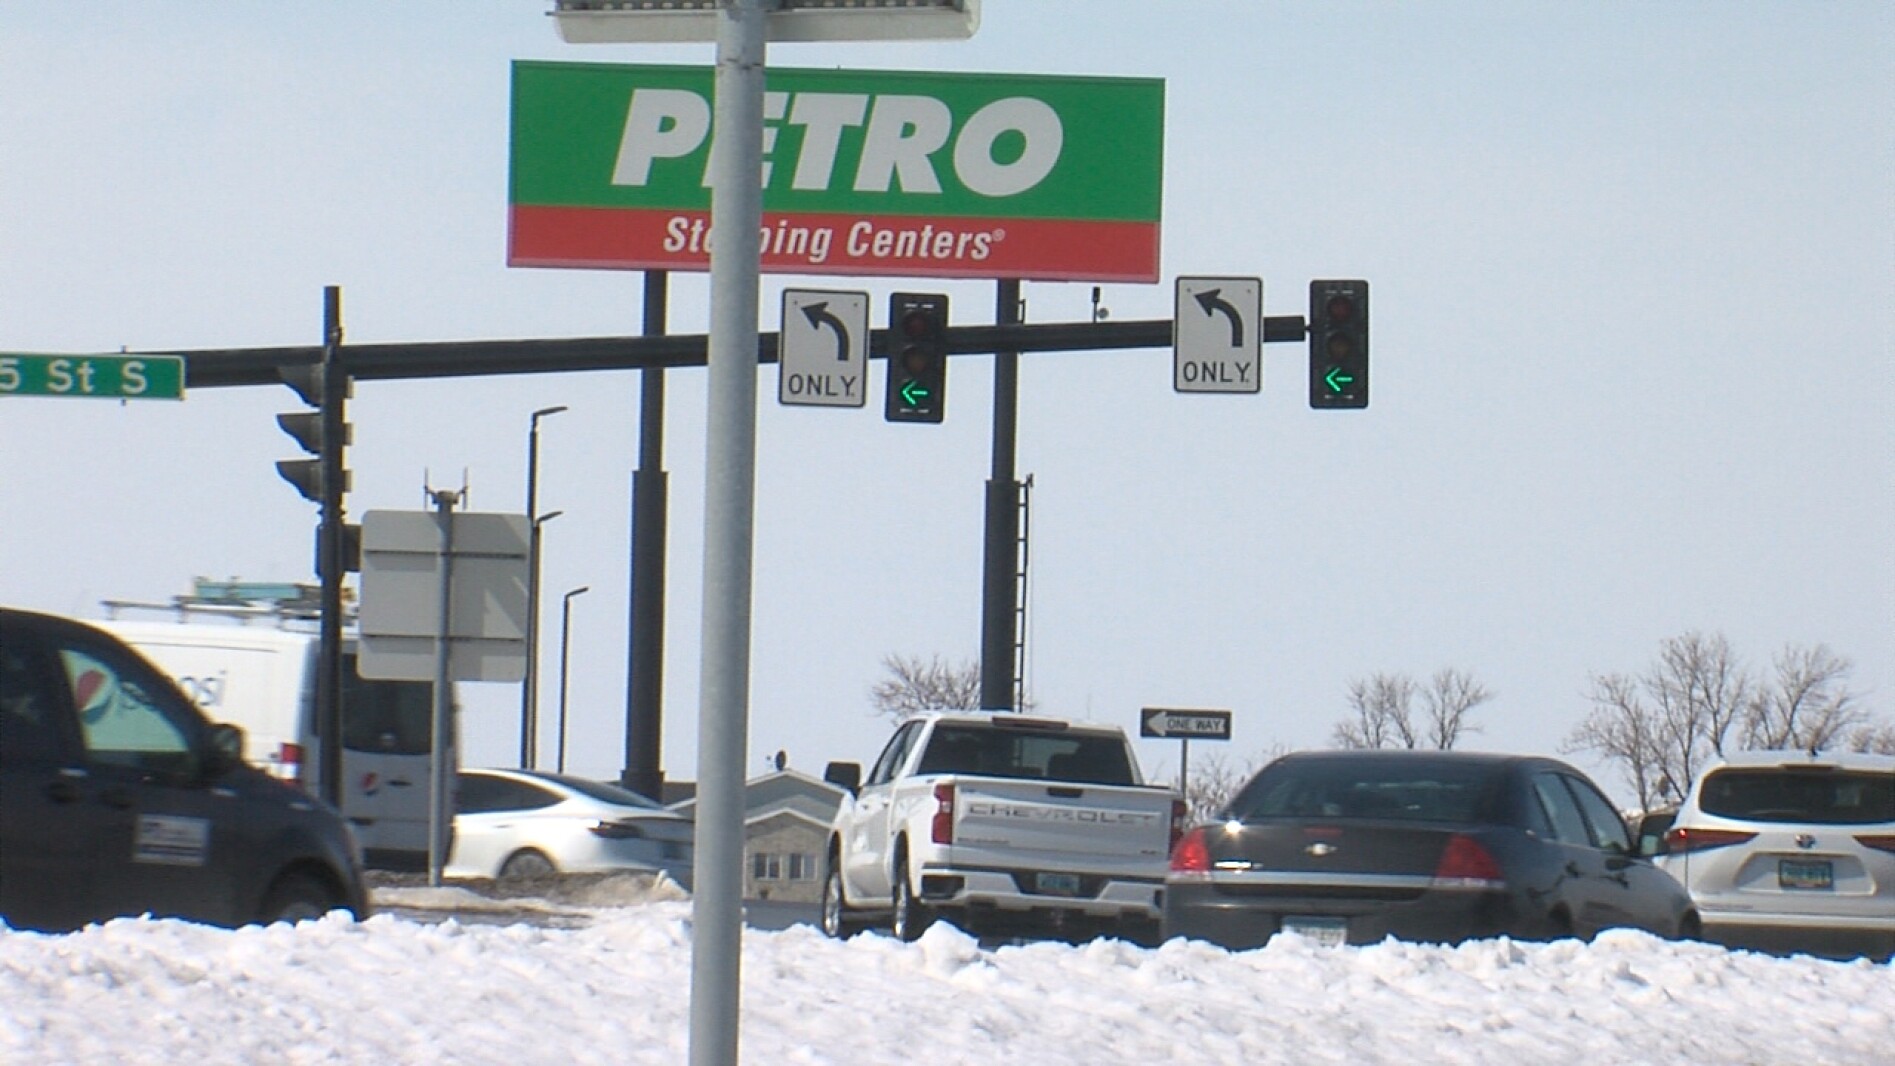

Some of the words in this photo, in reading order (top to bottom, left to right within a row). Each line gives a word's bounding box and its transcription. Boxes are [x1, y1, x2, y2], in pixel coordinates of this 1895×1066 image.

[663, 215, 832, 263] Sting
[47, 359, 95, 392] St
[121, 361, 147, 394] S
[1183, 361, 1251, 383] ONLY
[788, 373, 857, 396] ONLY
[1167, 717, 1191, 730] ONE
[1196, 719, 1222, 731] WAY
[969, 803, 1157, 825] CHEVROLET
